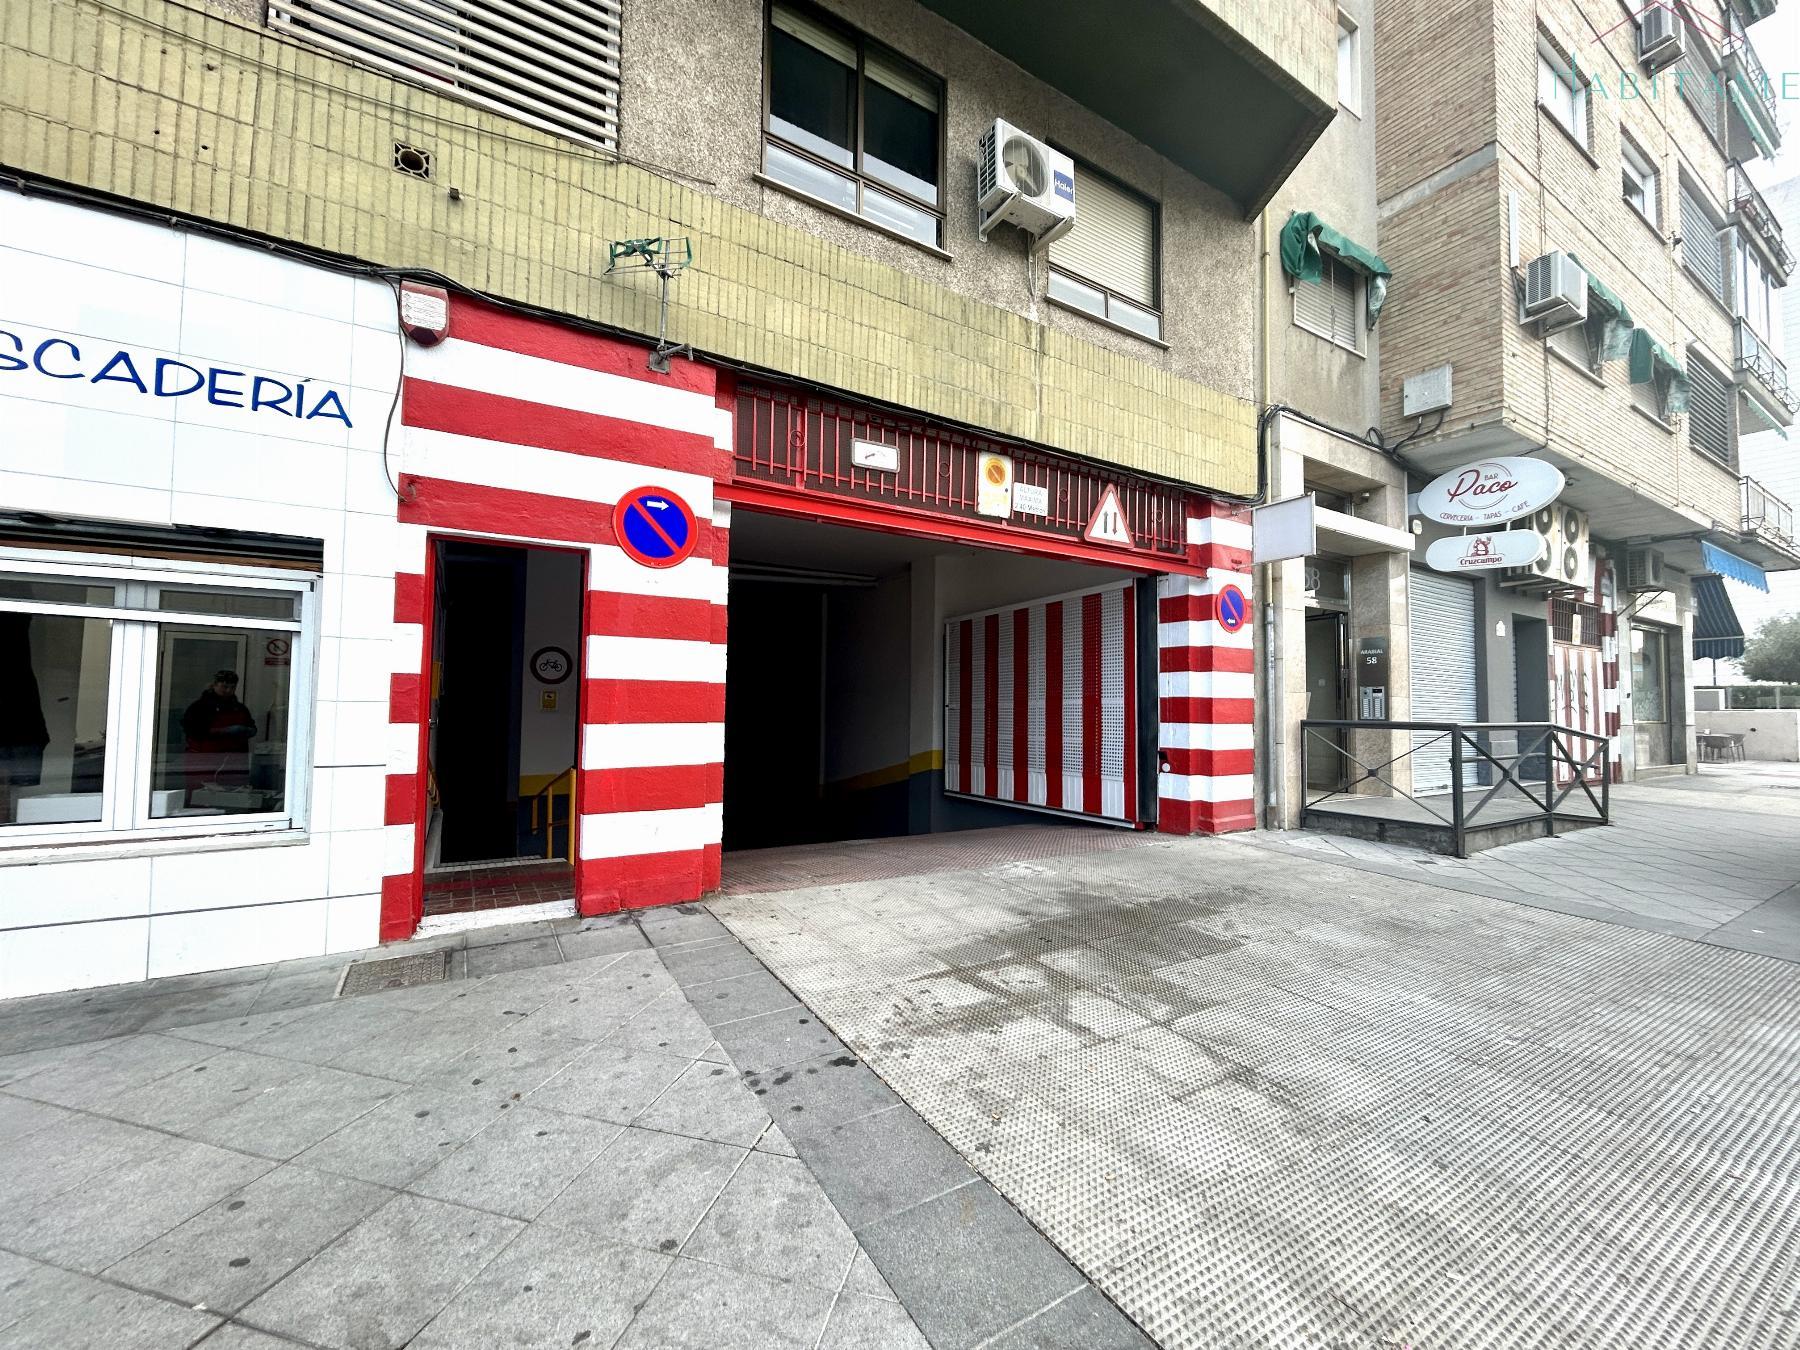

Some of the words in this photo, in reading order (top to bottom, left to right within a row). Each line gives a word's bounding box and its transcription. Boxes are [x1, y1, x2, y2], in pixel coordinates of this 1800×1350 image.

[1055, 179, 1073, 195] Haier
[0, 330, 353, 429] SCADERÍA
[1484, 473, 1499, 481] BAR
[1447, 469, 1518, 502] Paco
[1483, 511, 1503, 520] TAPAS
[1459, 556, 1503, 566] Cruzcampo
[1366, 656, 1378, 665] 58
